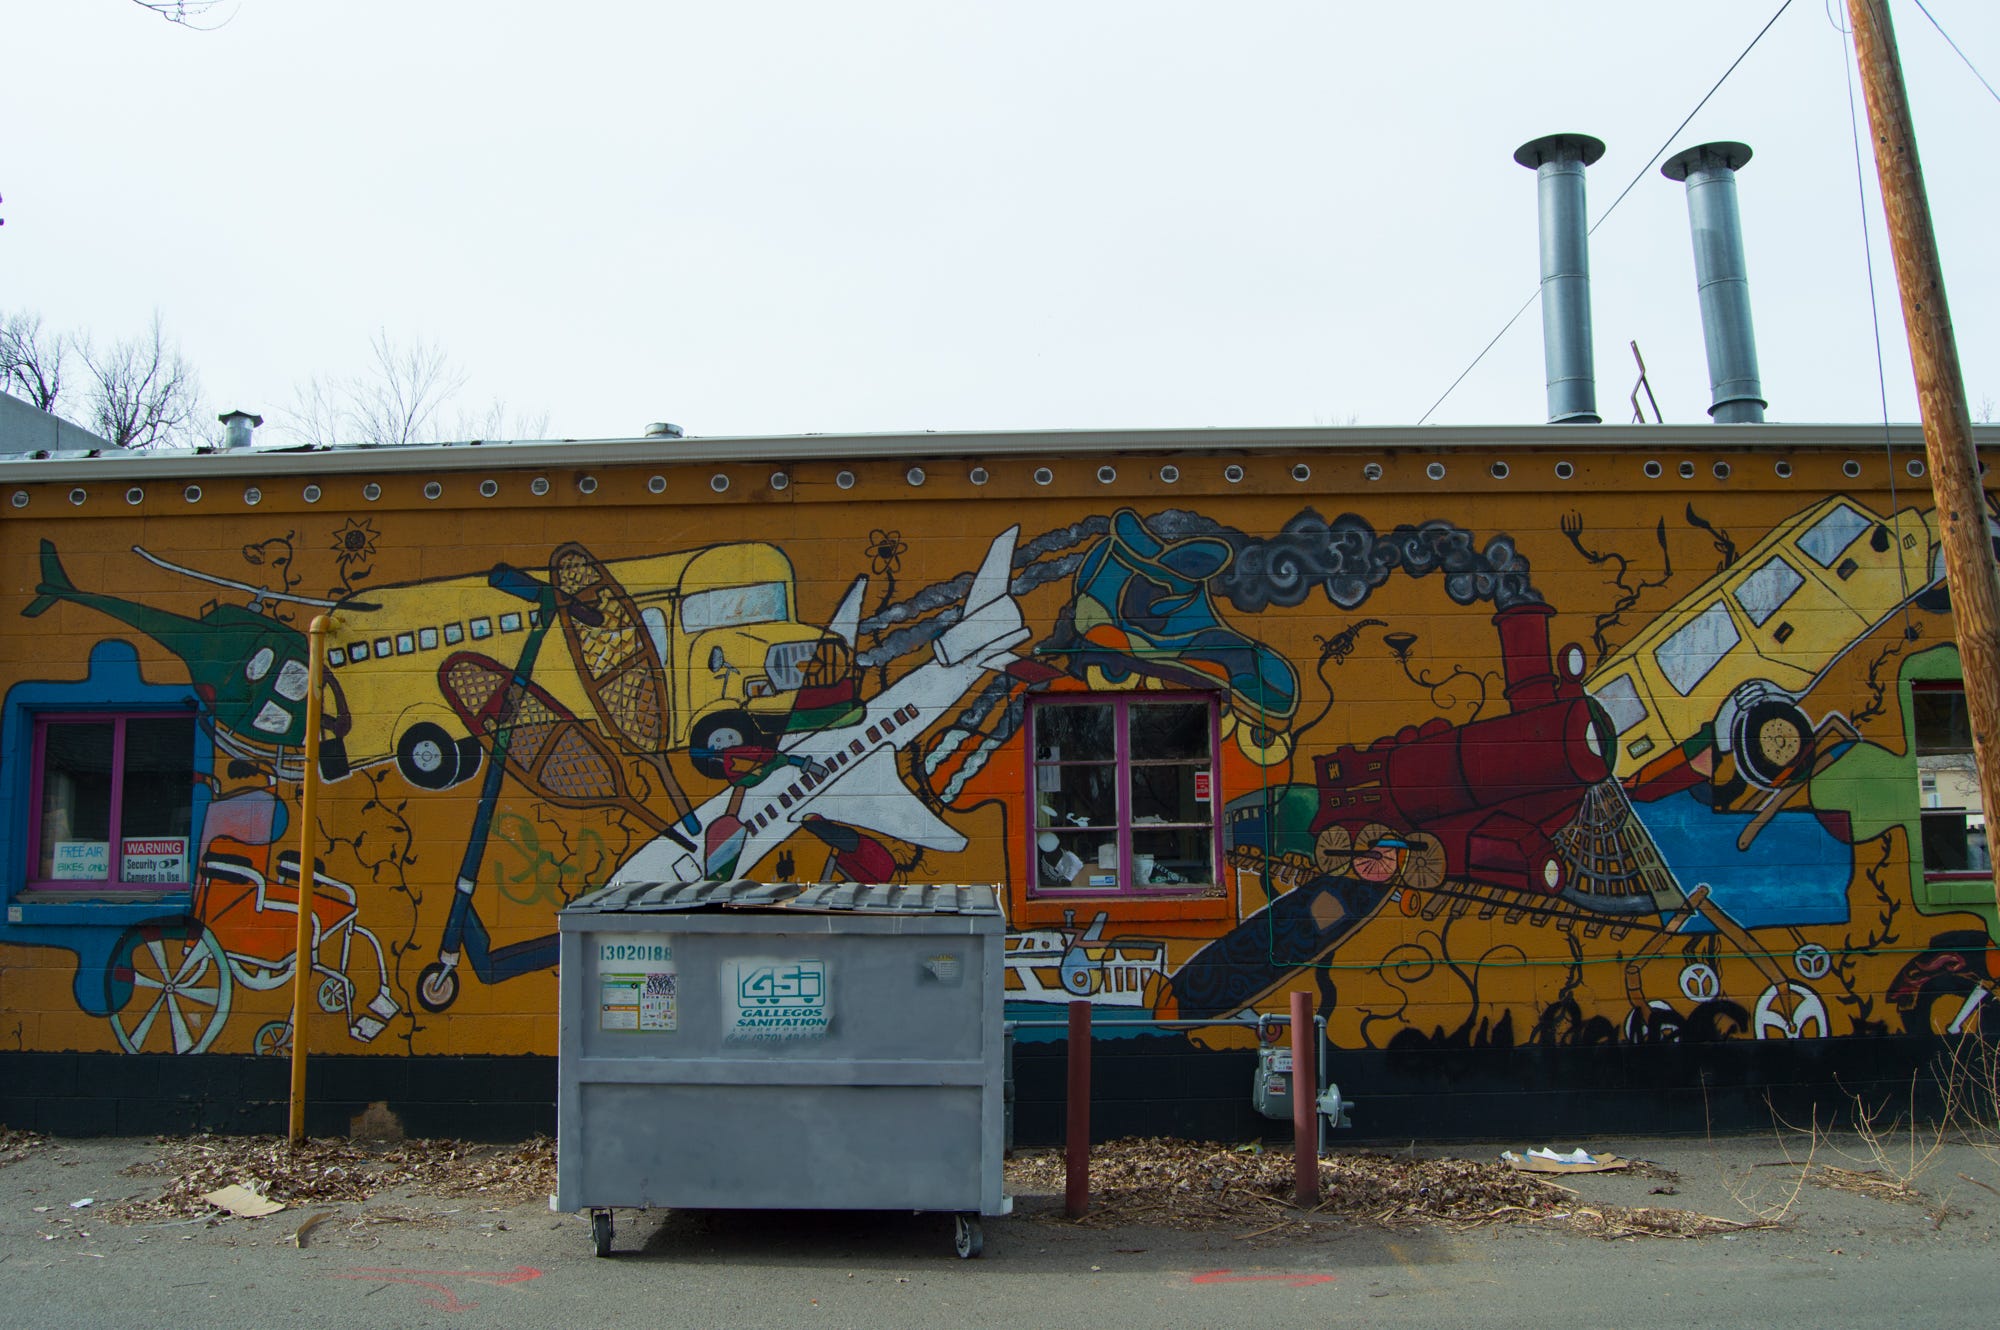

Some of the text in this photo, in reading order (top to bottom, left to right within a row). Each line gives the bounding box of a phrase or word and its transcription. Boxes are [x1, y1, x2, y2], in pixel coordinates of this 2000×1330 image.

[60, 845, 104, 858] FREE AIR
[127, 842, 182, 854] WARNING
[57, 862, 109, 873] BIKES ONLY
[127, 858, 157, 871] Security
[127, 871, 180, 882] Cameras In Use
[600, 945, 672, 961] 13020188
[741, 1008, 823, 1018] GALLEGOS
[736, 1018, 828, 1027] SANITATION
